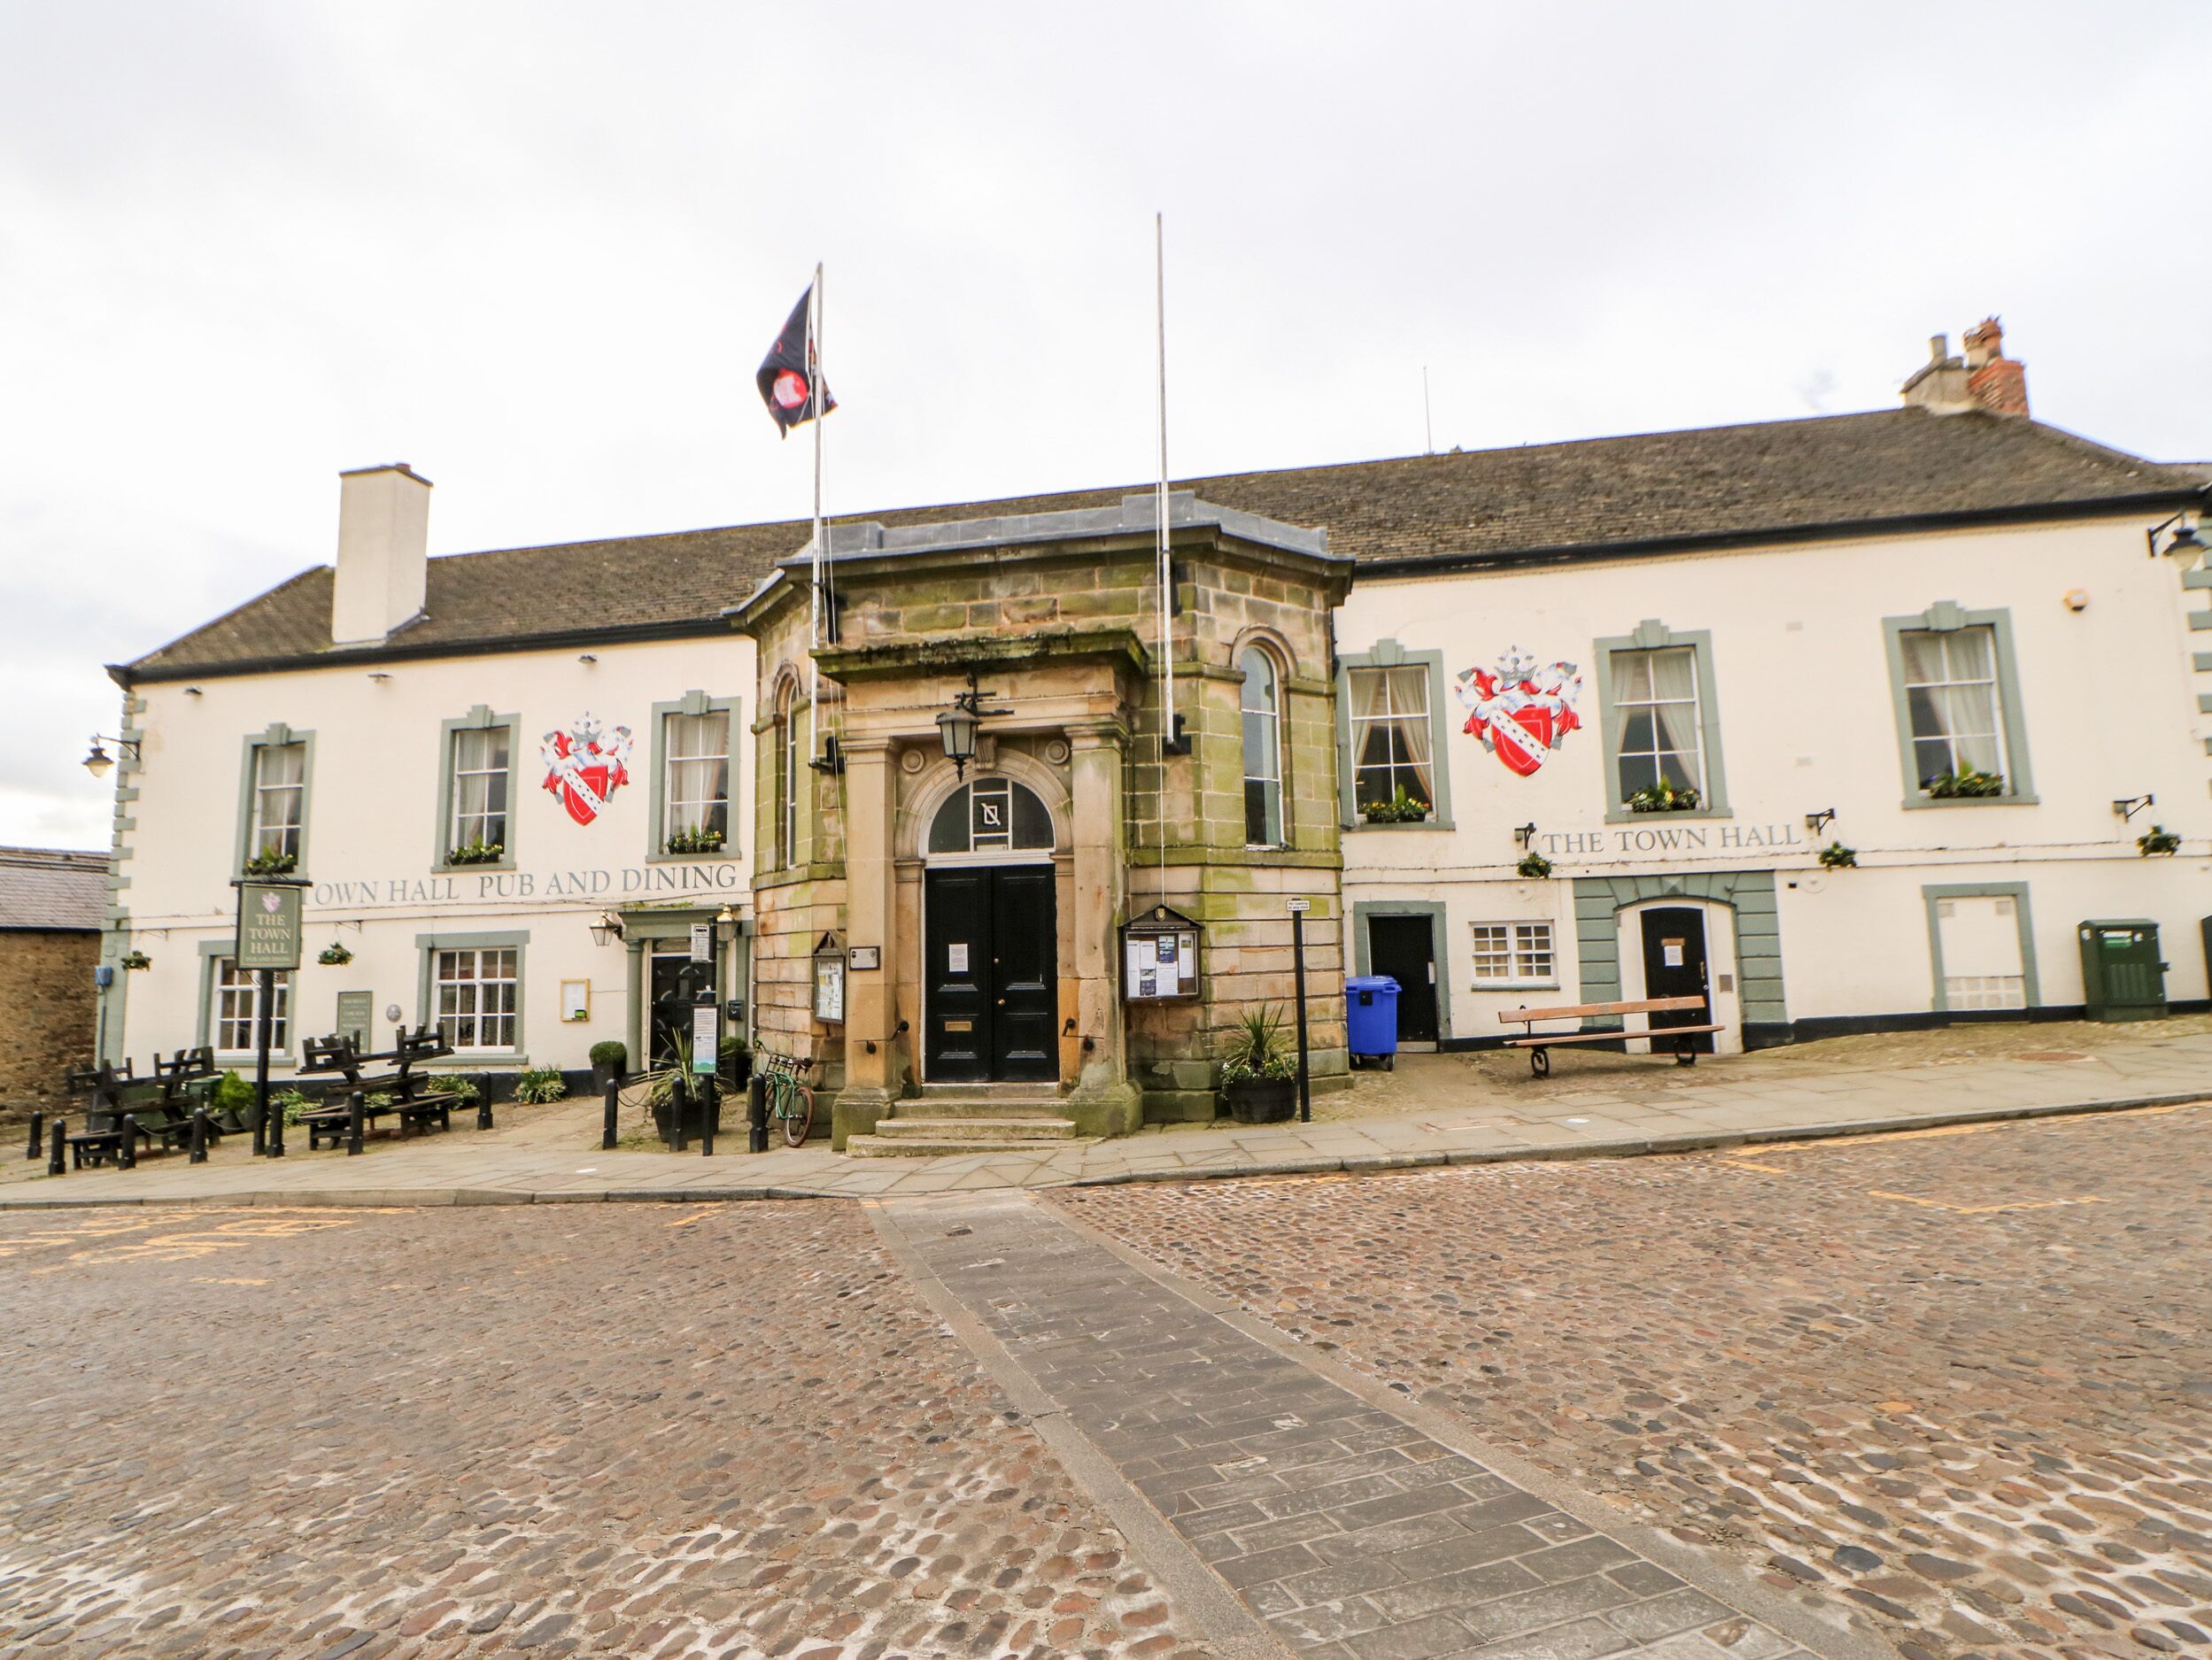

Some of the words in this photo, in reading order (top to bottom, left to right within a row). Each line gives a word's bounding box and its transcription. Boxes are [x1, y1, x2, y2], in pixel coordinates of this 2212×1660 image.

[1541, 831, 1605, 854] THE
[1614, 829, 1707, 852] TOWN
[1719, 823, 1801, 847] HALL
[303, 880, 378, 906] OWN
[388, 877, 461, 902] HALL
[478, 873, 535, 898] PUB
[545, 870, 611, 895] AND
[622, 864, 737, 892] DINING
[256, 913, 286, 927] THE
[248, 927, 291, 941] TOWN
[250, 941, 289, 954] HALL
